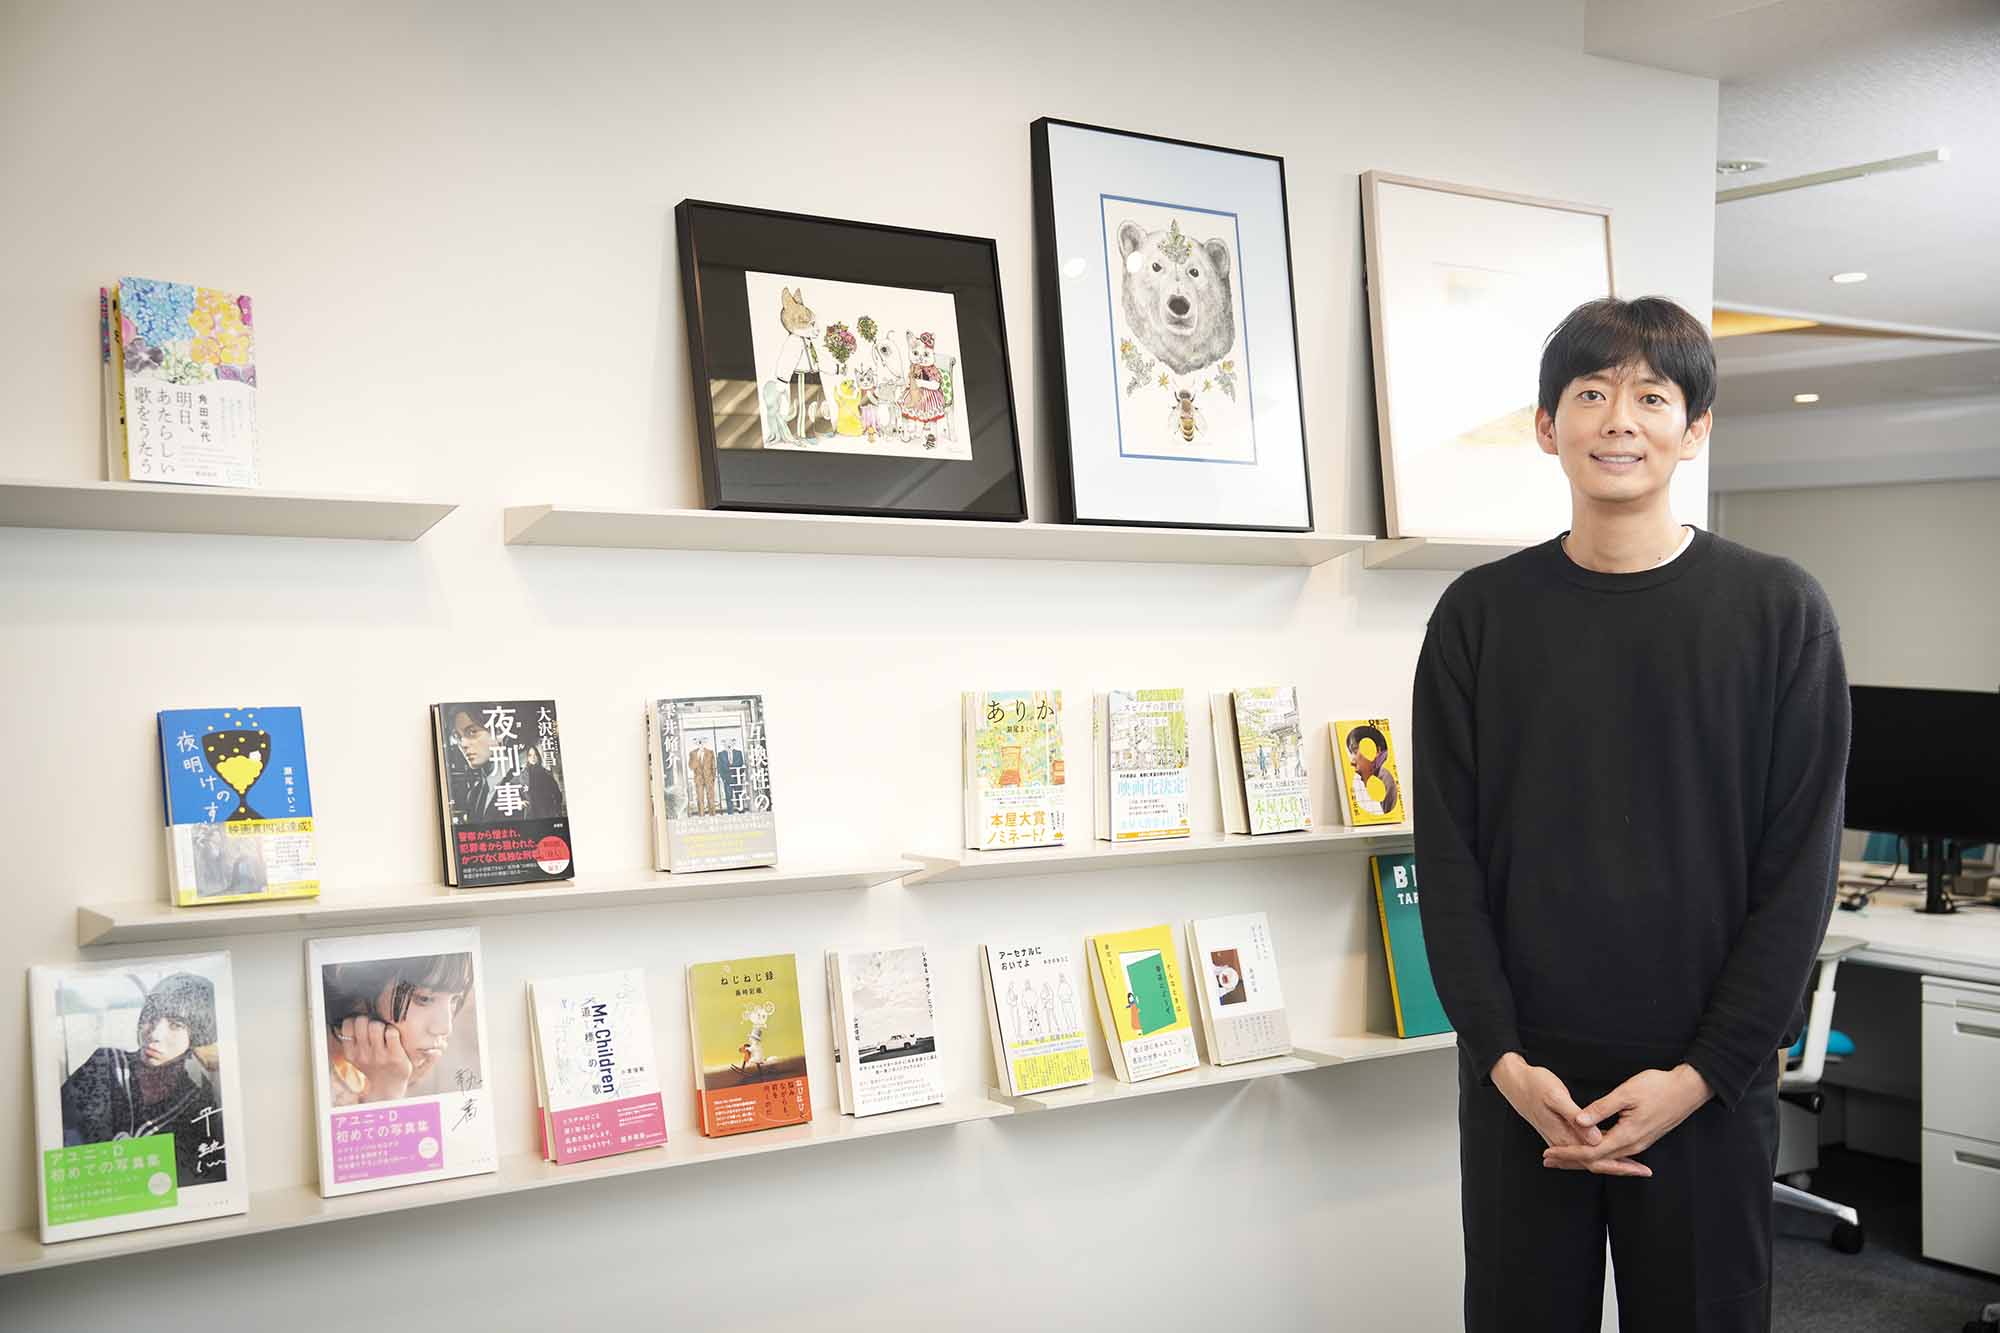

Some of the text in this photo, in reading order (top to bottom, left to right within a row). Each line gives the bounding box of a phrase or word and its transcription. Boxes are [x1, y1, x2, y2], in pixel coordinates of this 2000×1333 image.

[175, 390, 195, 433] 明日、
[134, 386, 153, 475] 歌をうたう
[157, 388, 176, 475] あたらしい
[986, 699, 1056, 724] ありか
[535, 705, 557, 771] 大沢在昌
[481, 705, 520, 817] 夜刑事
[729, 765, 751, 812] 王子
[990, 810, 1048, 828] 本屋大賞
[987, 828, 1047, 845] ノミネート!
[999, 946, 1043, 960] アーセナルに
[720, 970, 775, 986] ねじねじ録
[335, 1119, 431, 1144] 初めての写真集
